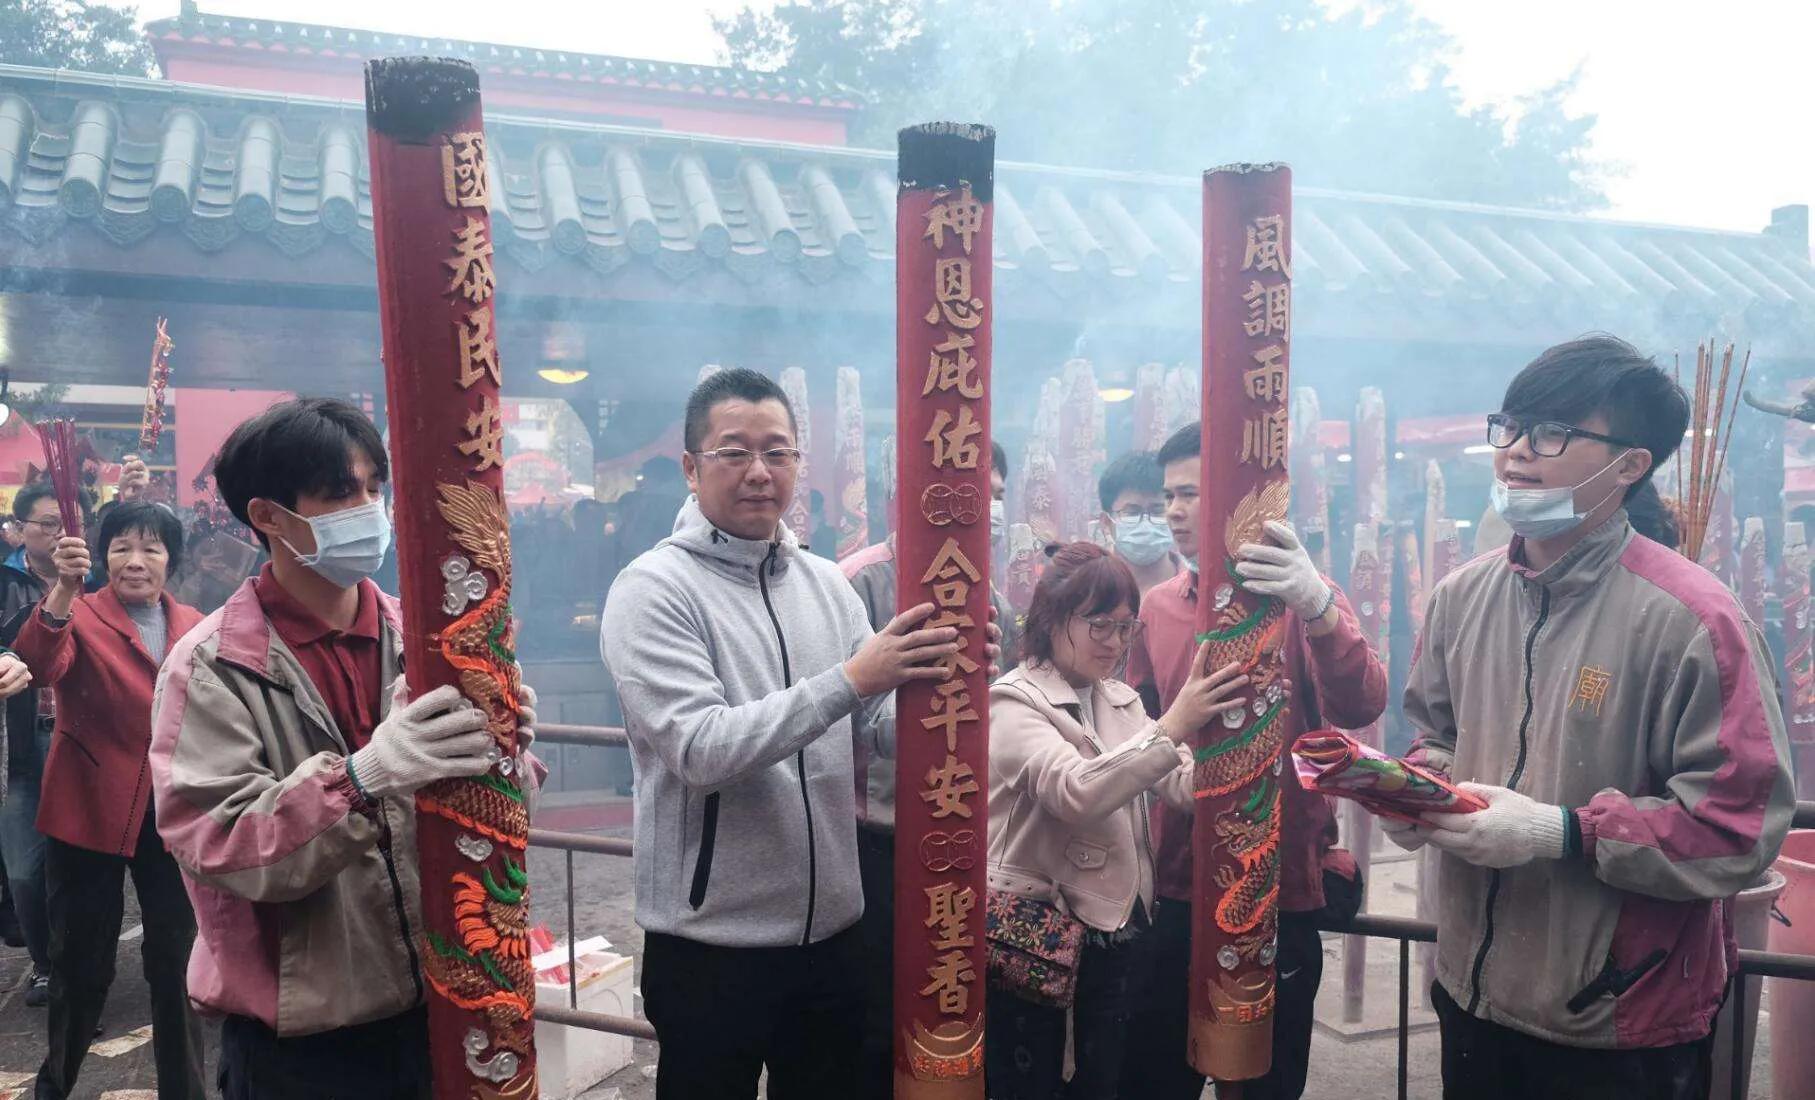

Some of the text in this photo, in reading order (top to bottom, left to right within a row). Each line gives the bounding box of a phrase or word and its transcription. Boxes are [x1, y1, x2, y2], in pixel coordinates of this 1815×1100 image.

[441, 131, 503, 472] 國泰民安
[922, 181, 985, 470] 神恩庇佑
[1241, 214, 1293, 472] 風調雨順
[1568, 664, 1612, 717] 廟
[922, 881, 978, 1014] 聖香
